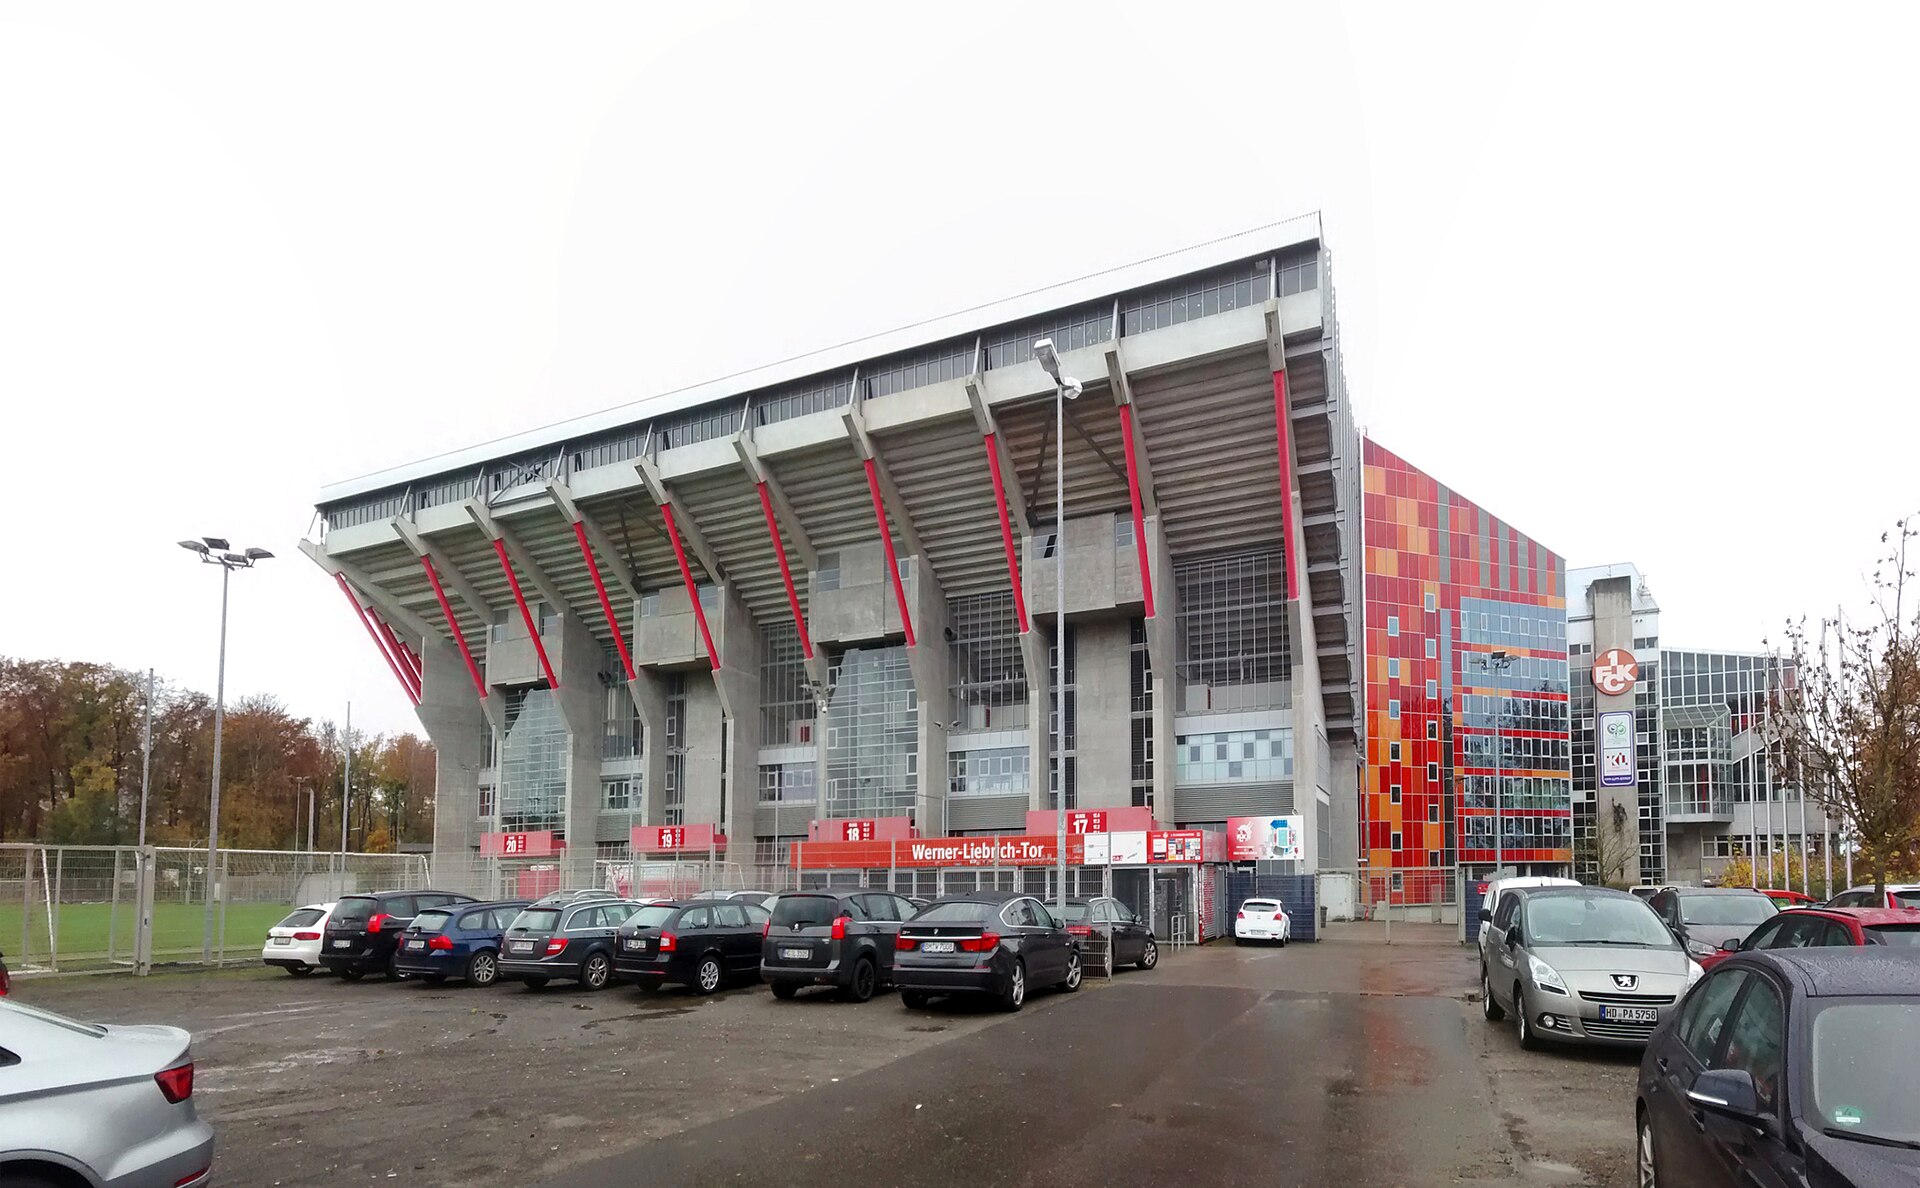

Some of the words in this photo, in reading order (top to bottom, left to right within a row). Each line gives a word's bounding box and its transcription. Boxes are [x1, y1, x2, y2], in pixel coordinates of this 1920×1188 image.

[846, 827, 860, 841] 18
[1072, 819, 1089, 835] 17
[506, 839, 517, 853] 20
[661, 833, 673, 848] 19
[911, 841, 1045, 861] Werner-Liebrich-Tor
[1606, 1008, 1617, 1018] HD
[1622, 1009, 1634, 1020] PA
[1635, 1009, 1656, 1020] 5758
